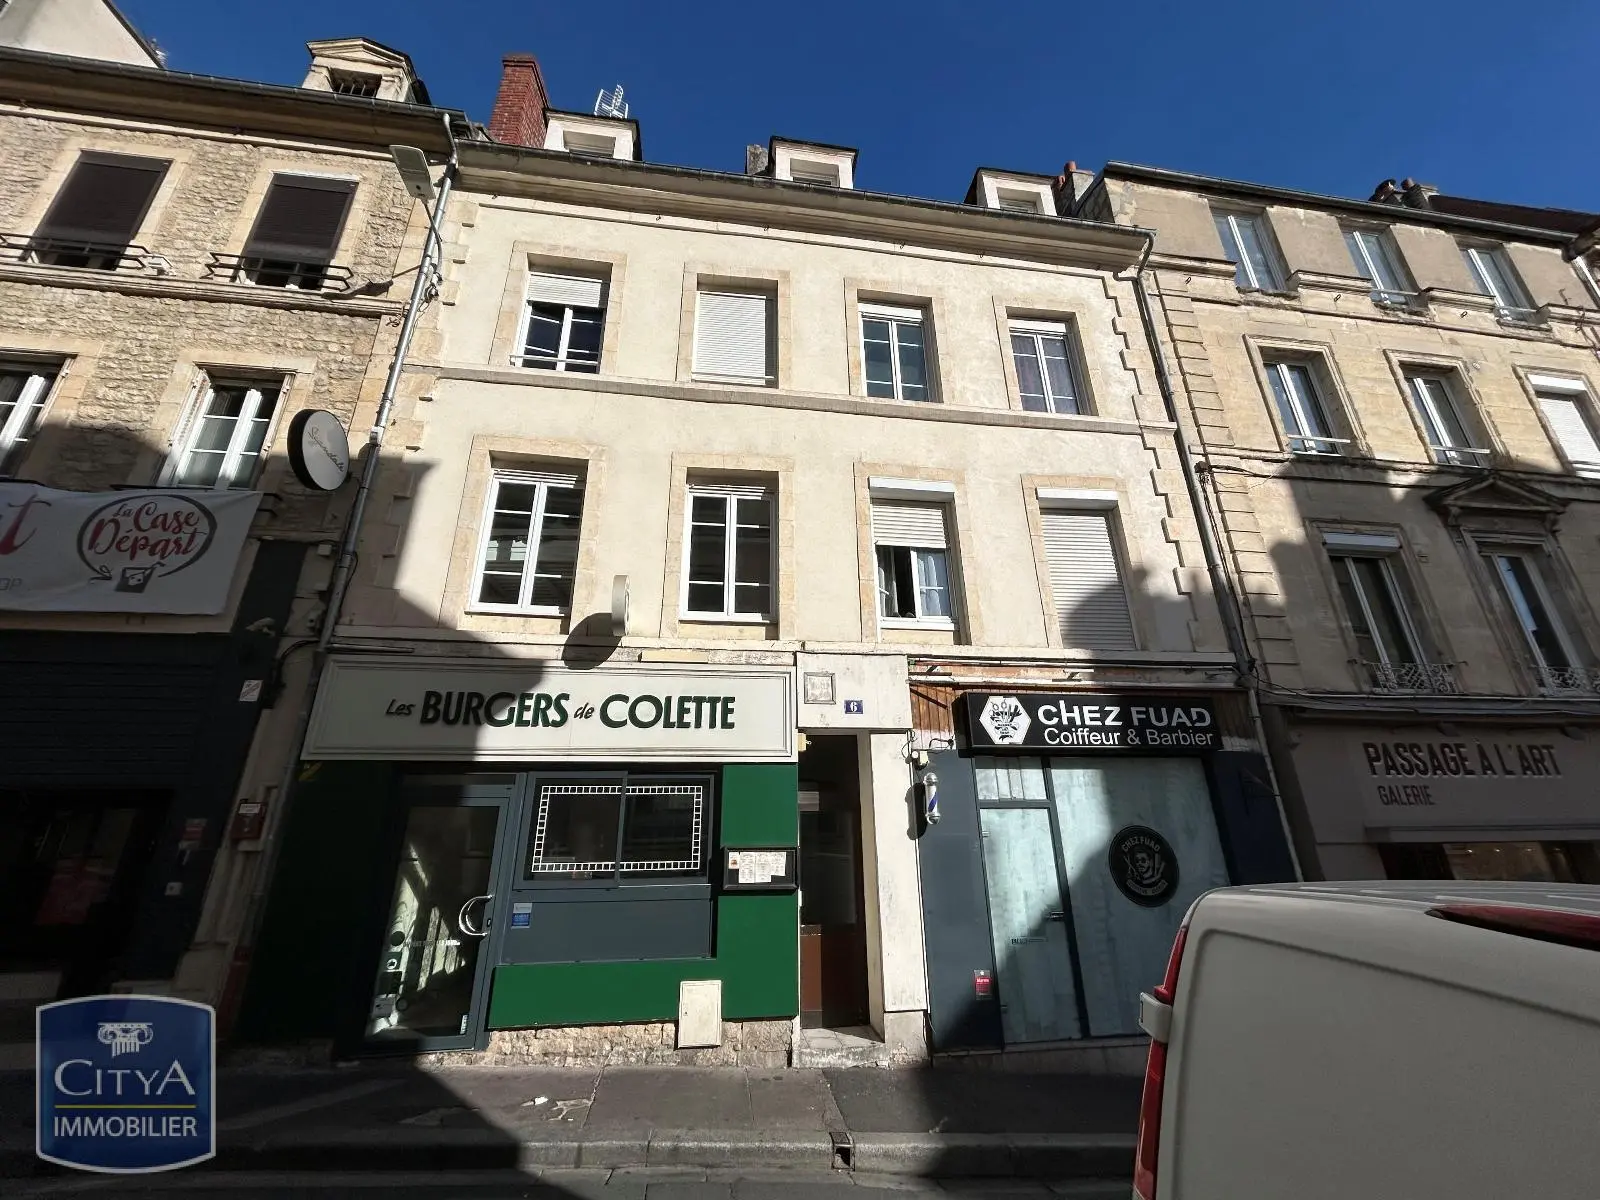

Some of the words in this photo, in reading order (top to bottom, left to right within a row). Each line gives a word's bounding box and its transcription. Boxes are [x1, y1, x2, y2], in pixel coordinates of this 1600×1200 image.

[112, 503, 134, 518] La
[133, 502, 200, 534] Case
[88, 517, 207, 562] Départ
[385, 699, 415, 716] Les
[419, 690, 570, 728] BURGERS
[573, 702, 595, 720] de
[599, 693, 736, 730] COLETTE
[850, 701, 858, 713] 6
[1037, 700, 1123, 726] CHEZ
[1130, 706, 1212, 727] FUAD
[1044, 727, 1121, 746] Coiffeur
[1127, 728, 1141, 746] &
[1146, 729, 1214, 746] Barbier
[1362, 742, 1476, 777] PASSAGE
[1494, 743, 1563, 777] L'ART
[1377, 785, 1436, 806] GALERIE
[1121, 836, 1140, 852] CHEZ
[1140, 836, 1161, 852] FUAD
